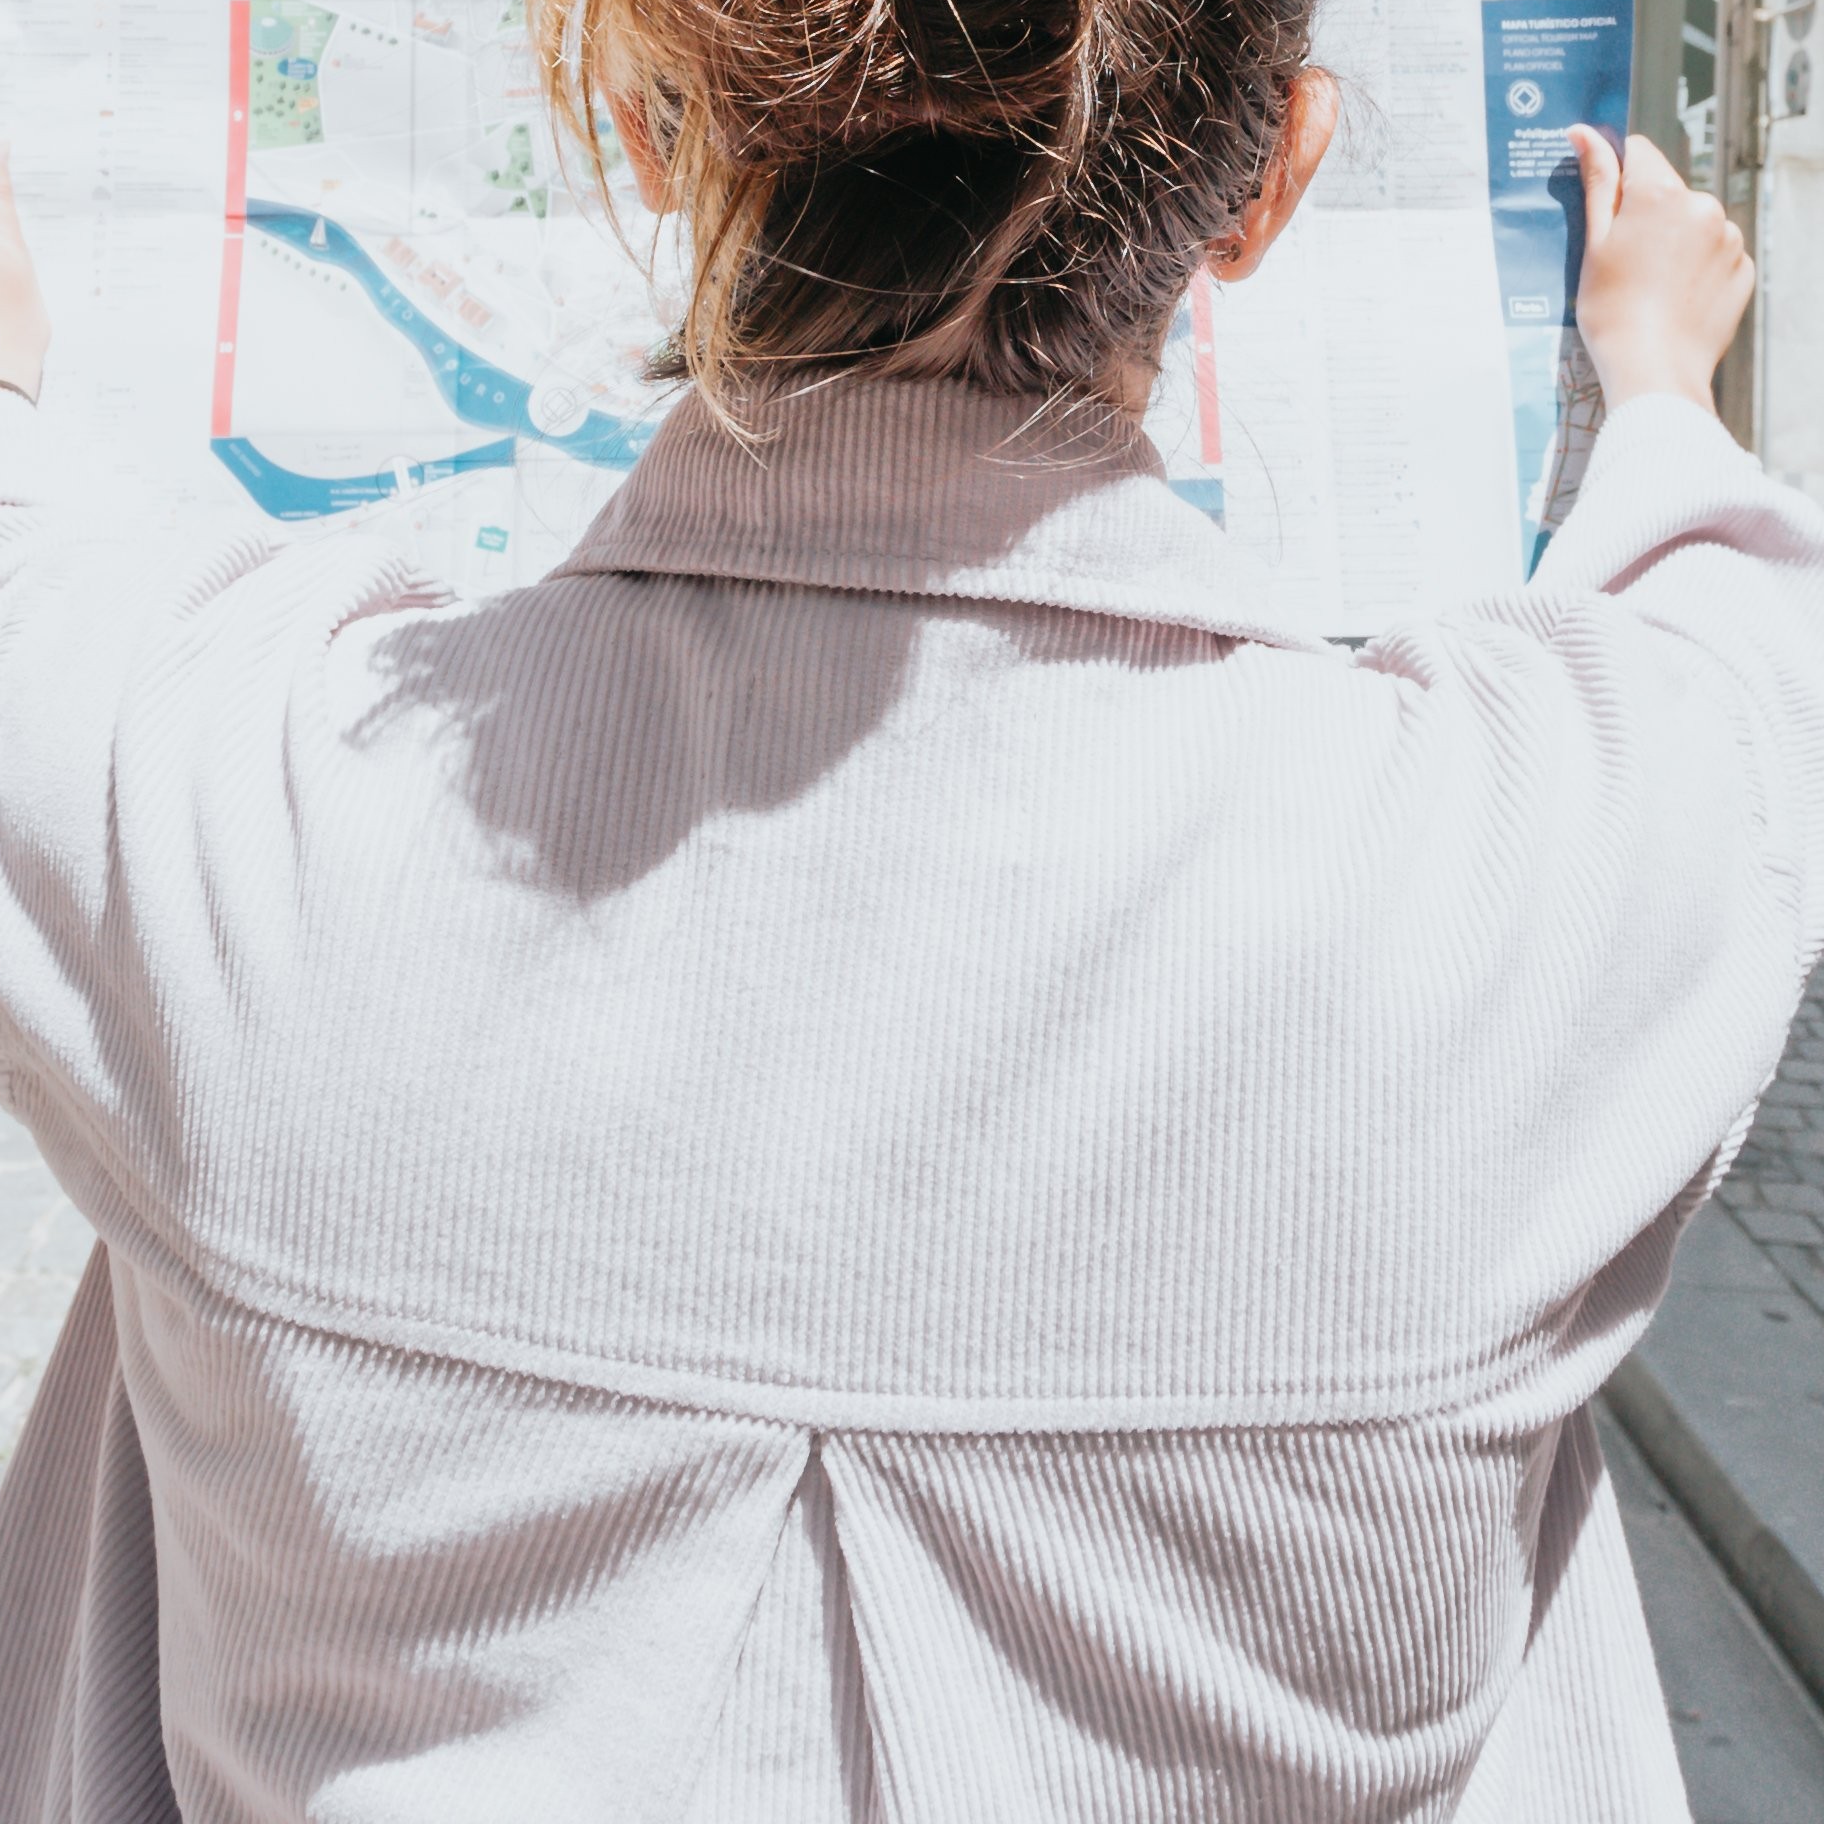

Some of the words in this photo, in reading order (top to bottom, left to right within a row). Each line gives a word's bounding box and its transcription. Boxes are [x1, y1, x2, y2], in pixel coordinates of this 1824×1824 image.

[1501, 19, 1528, 30] MAPA
[1528, 17, 1579, 30] TURÍSTICO
[1579, 16, 1617, 28] OFICIAL
